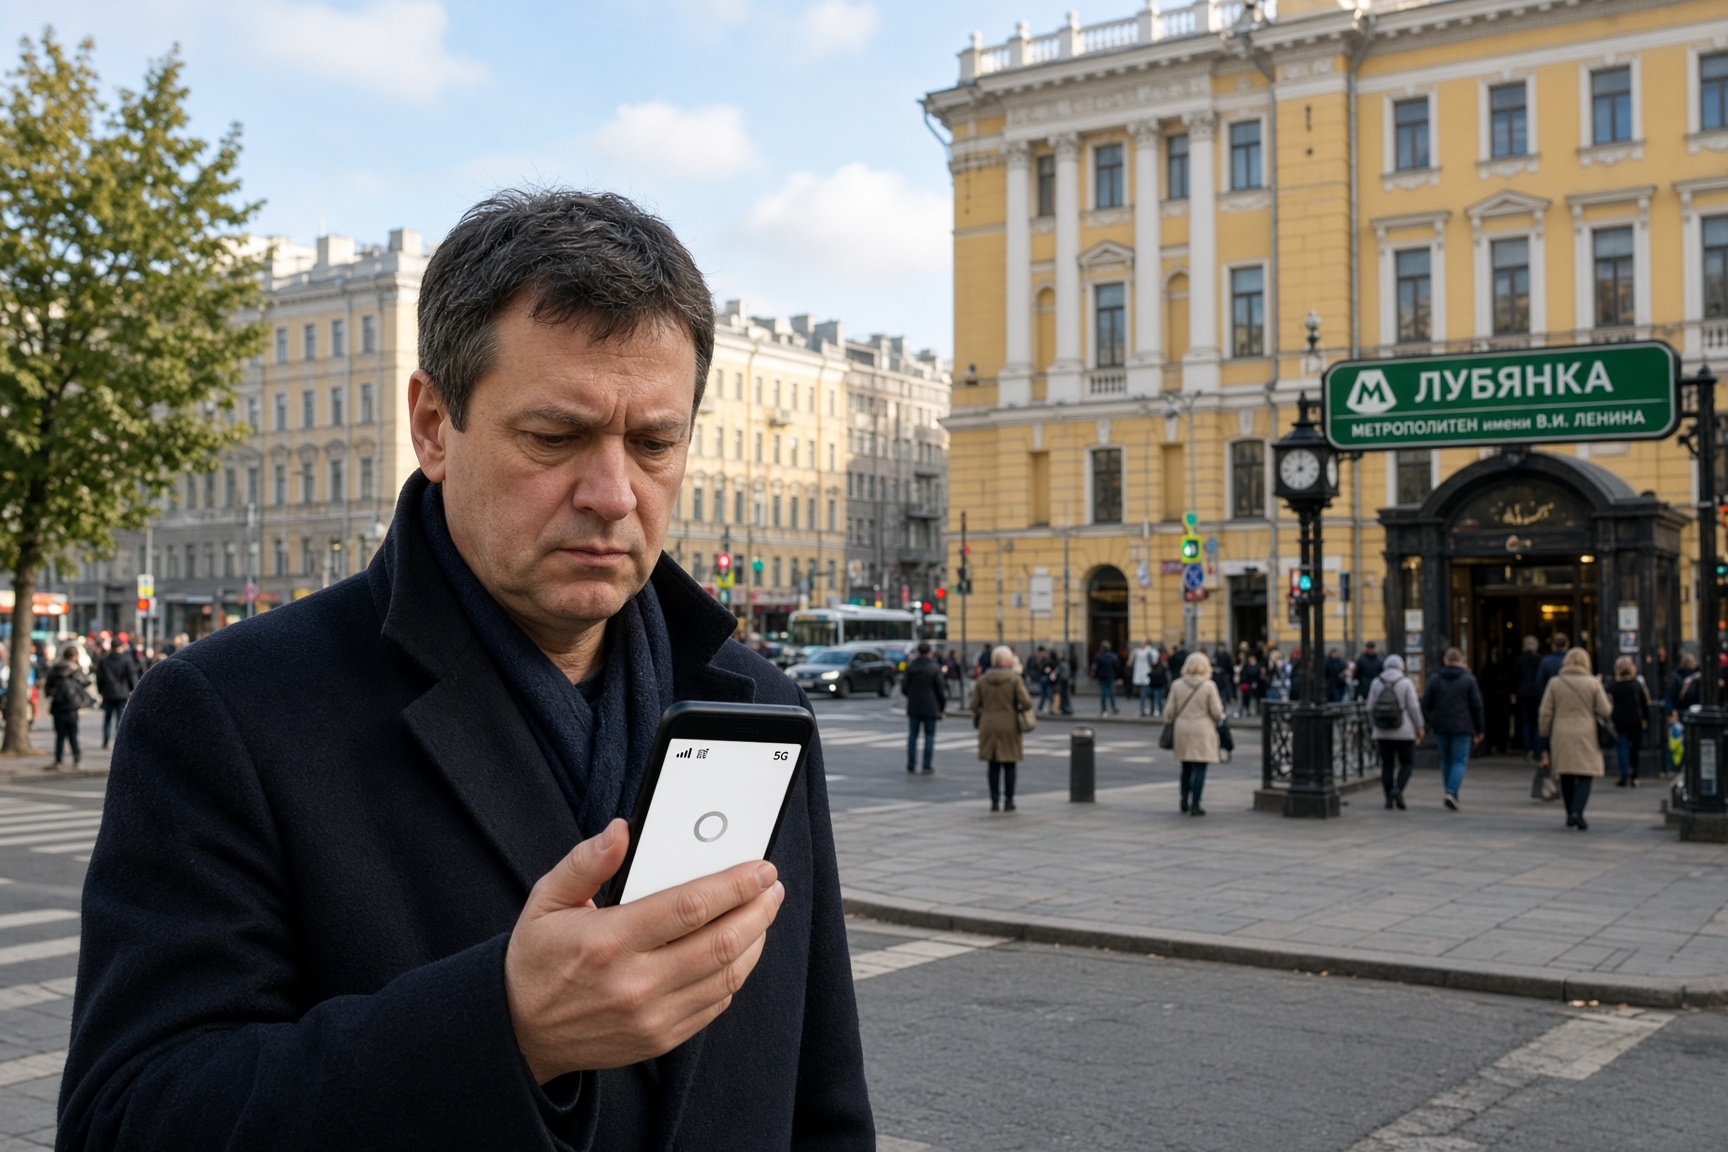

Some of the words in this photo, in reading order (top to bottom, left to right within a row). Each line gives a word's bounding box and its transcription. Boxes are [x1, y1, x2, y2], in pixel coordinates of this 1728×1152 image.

[1414, 360, 1614, 403] ЛУБЯНКА
[1351, 417, 1478, 438] МЕТРОПОЛИТЕН
[1536, 413, 1569, 429] В.И.
[1573, 409, 1646, 428] ЛЕНИНА
[773, 751, 789, 761] 5G
